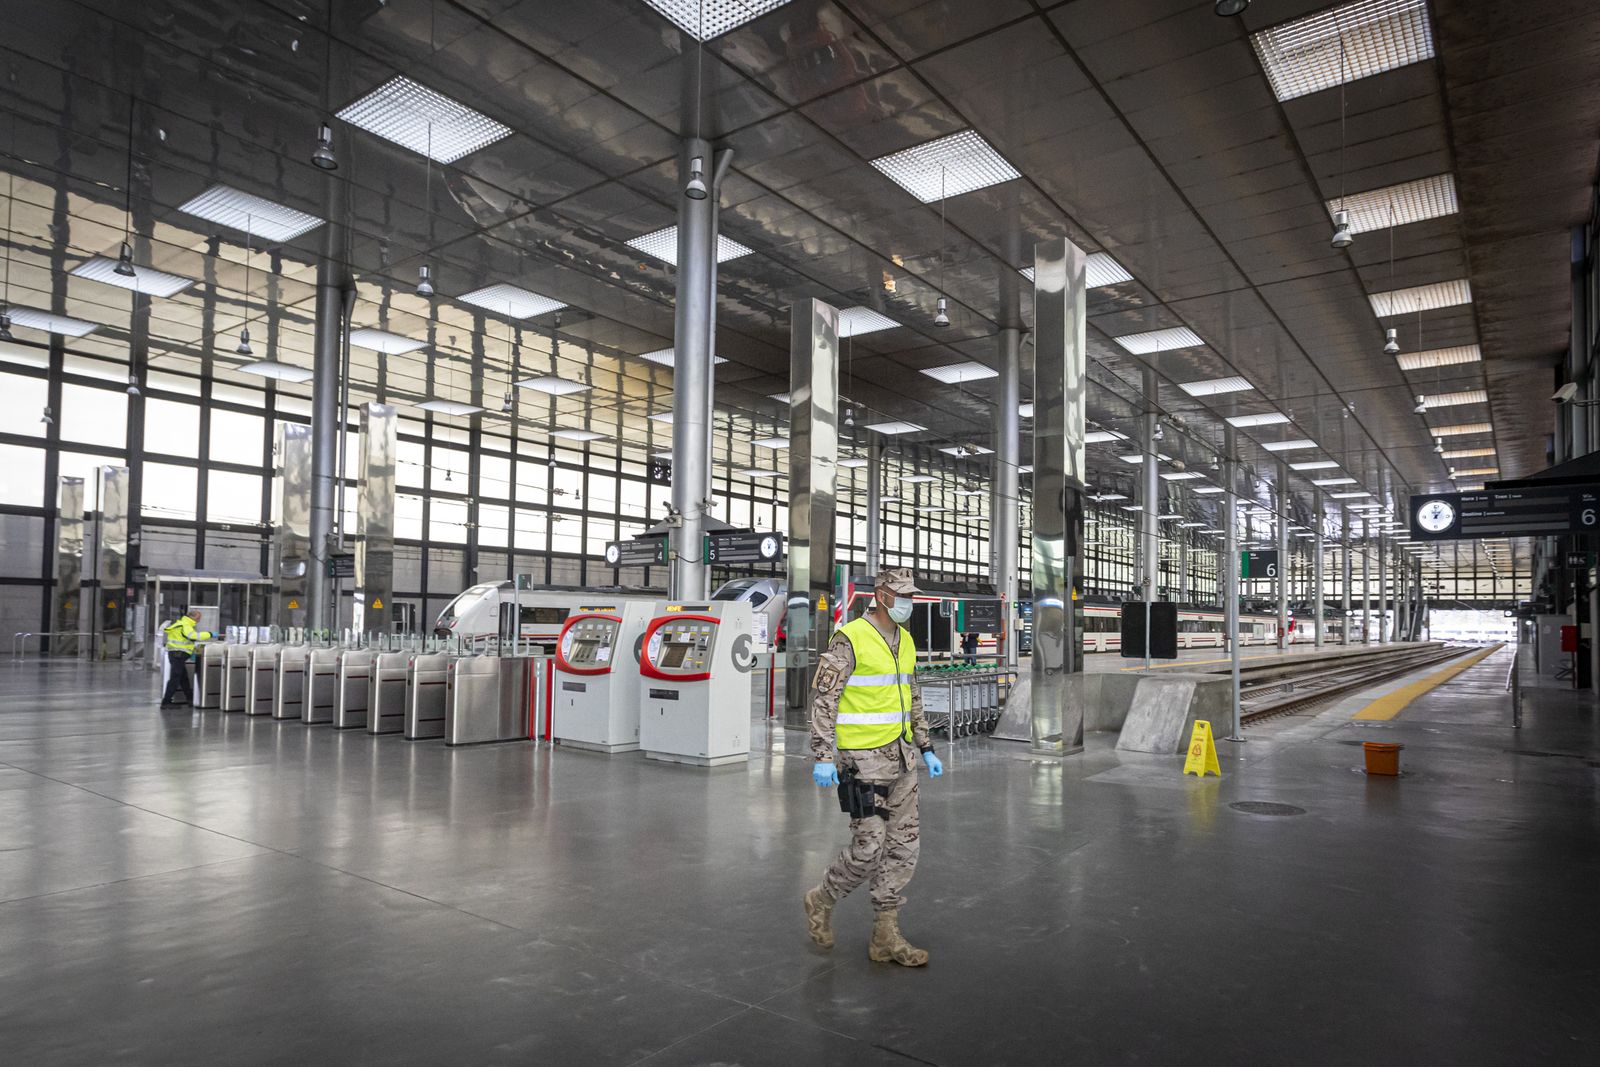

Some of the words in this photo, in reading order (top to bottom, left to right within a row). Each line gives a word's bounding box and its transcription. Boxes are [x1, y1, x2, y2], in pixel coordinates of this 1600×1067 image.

[1581, 508, 1596, 526] 6
[657, 551, 663, 561] 4
[709, 549, 716, 560] 5
[1266, 563, 1276, 577] 6
